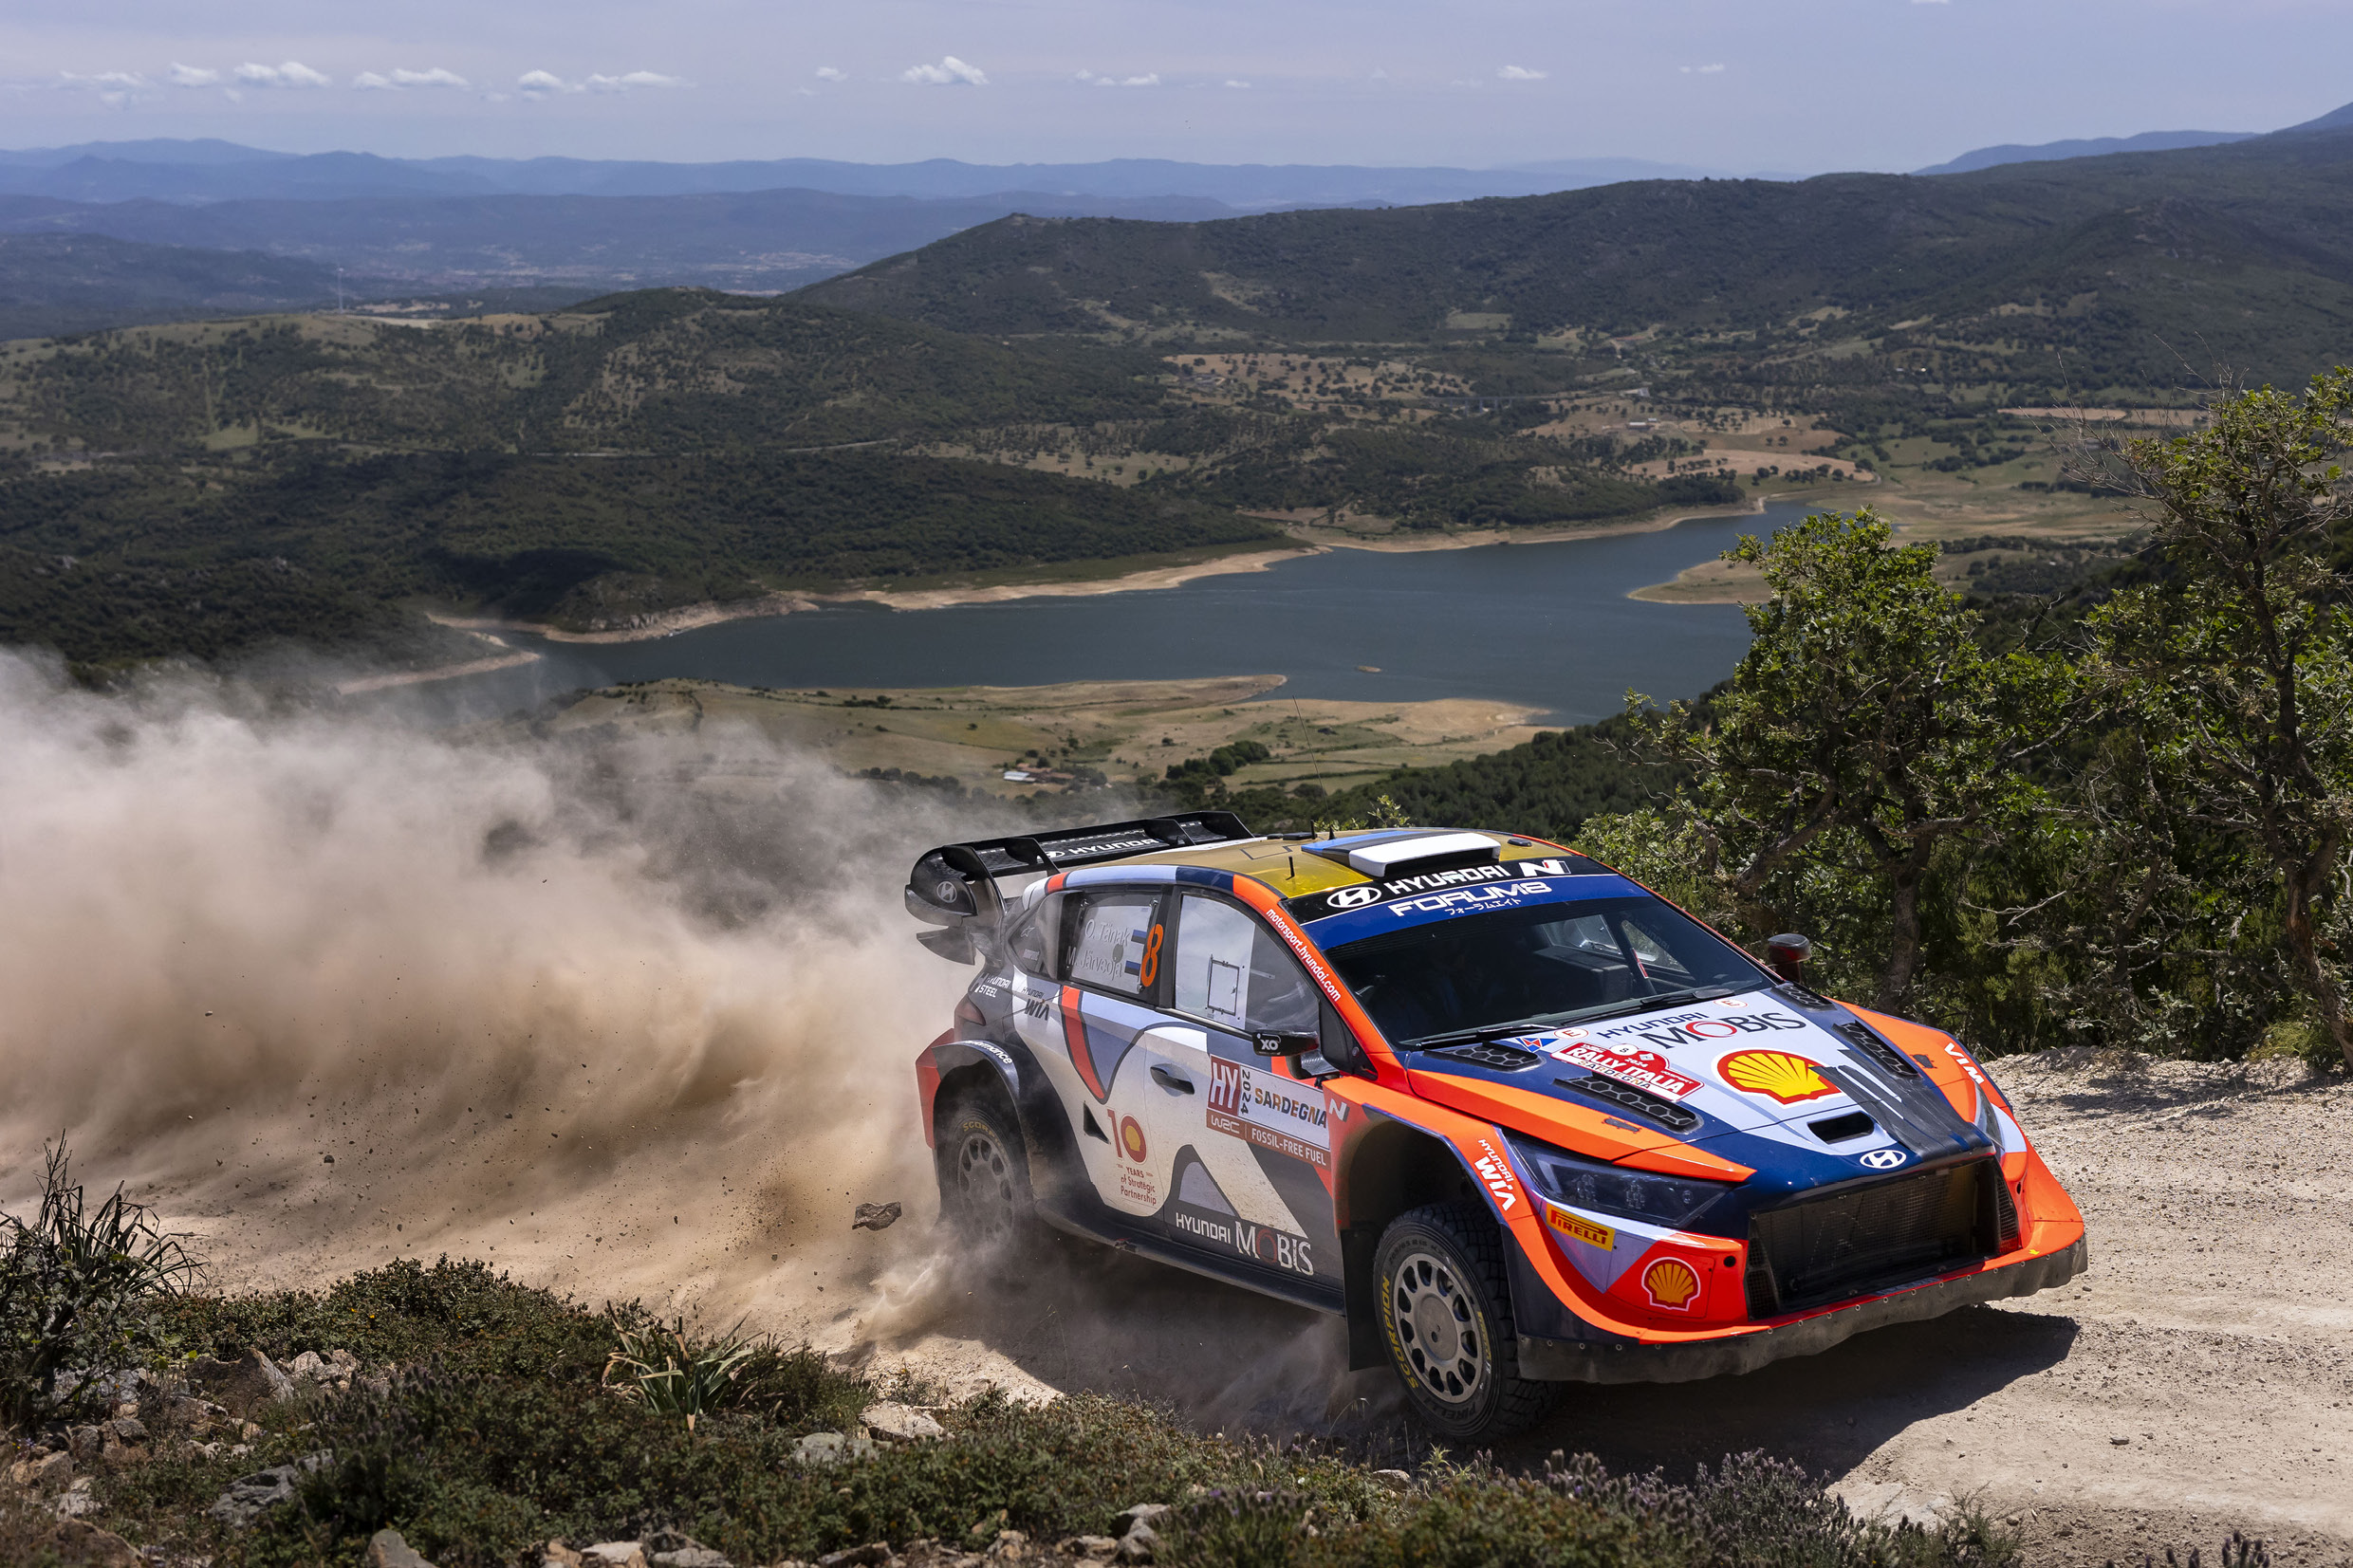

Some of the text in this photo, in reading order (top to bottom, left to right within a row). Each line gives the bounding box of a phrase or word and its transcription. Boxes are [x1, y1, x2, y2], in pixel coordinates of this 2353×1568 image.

[1384, 865, 1511, 895] HYUNDAI
[1388, 881, 1553, 917] FORUM8
[1140, 923, 1164, 987] 8
[1266, 909, 1342, 1002] motorsport.hyundai.com
[979, 985, 998, 998] STEEL
[1022, 987, 1045, 999] HYUNDAI
[1025, 999, 1050, 1022] WIA
[1597, 1012, 1710, 1040] HYUNDAI
[1637, 1012, 1806, 1050] MOBIS
[1210, 1062, 1239, 1109] HY
[1566, 1047, 1628, 1071] RALLY
[1623, 1065, 1686, 1094] ITALIA
[1578, 1060, 1652, 1090] SARDEGNA
[1240, 1069, 1251, 1115] 2024
[1254, 1087, 1327, 1129] SARDEGNA
[1211, 1115, 1240, 1134] WRC
[1251, 1127, 1327, 1167] FOSSIL-FREE FUEL
[1478, 1138, 1515, 1183] HYUNDAI
[1121, 1174, 1156, 1194] of Strategic
[1126, 1166, 1145, 1179] YEARS
[1474, 1156, 1517, 1211] WIA
[1121, 1186, 1157, 1206] Partnership
[1176, 1212, 1314, 1276] HYUNDAI MOBIS
[1550, 1209, 1609, 1245] PIRELLI
[1381, 1272, 1419, 1390] SCORPION
